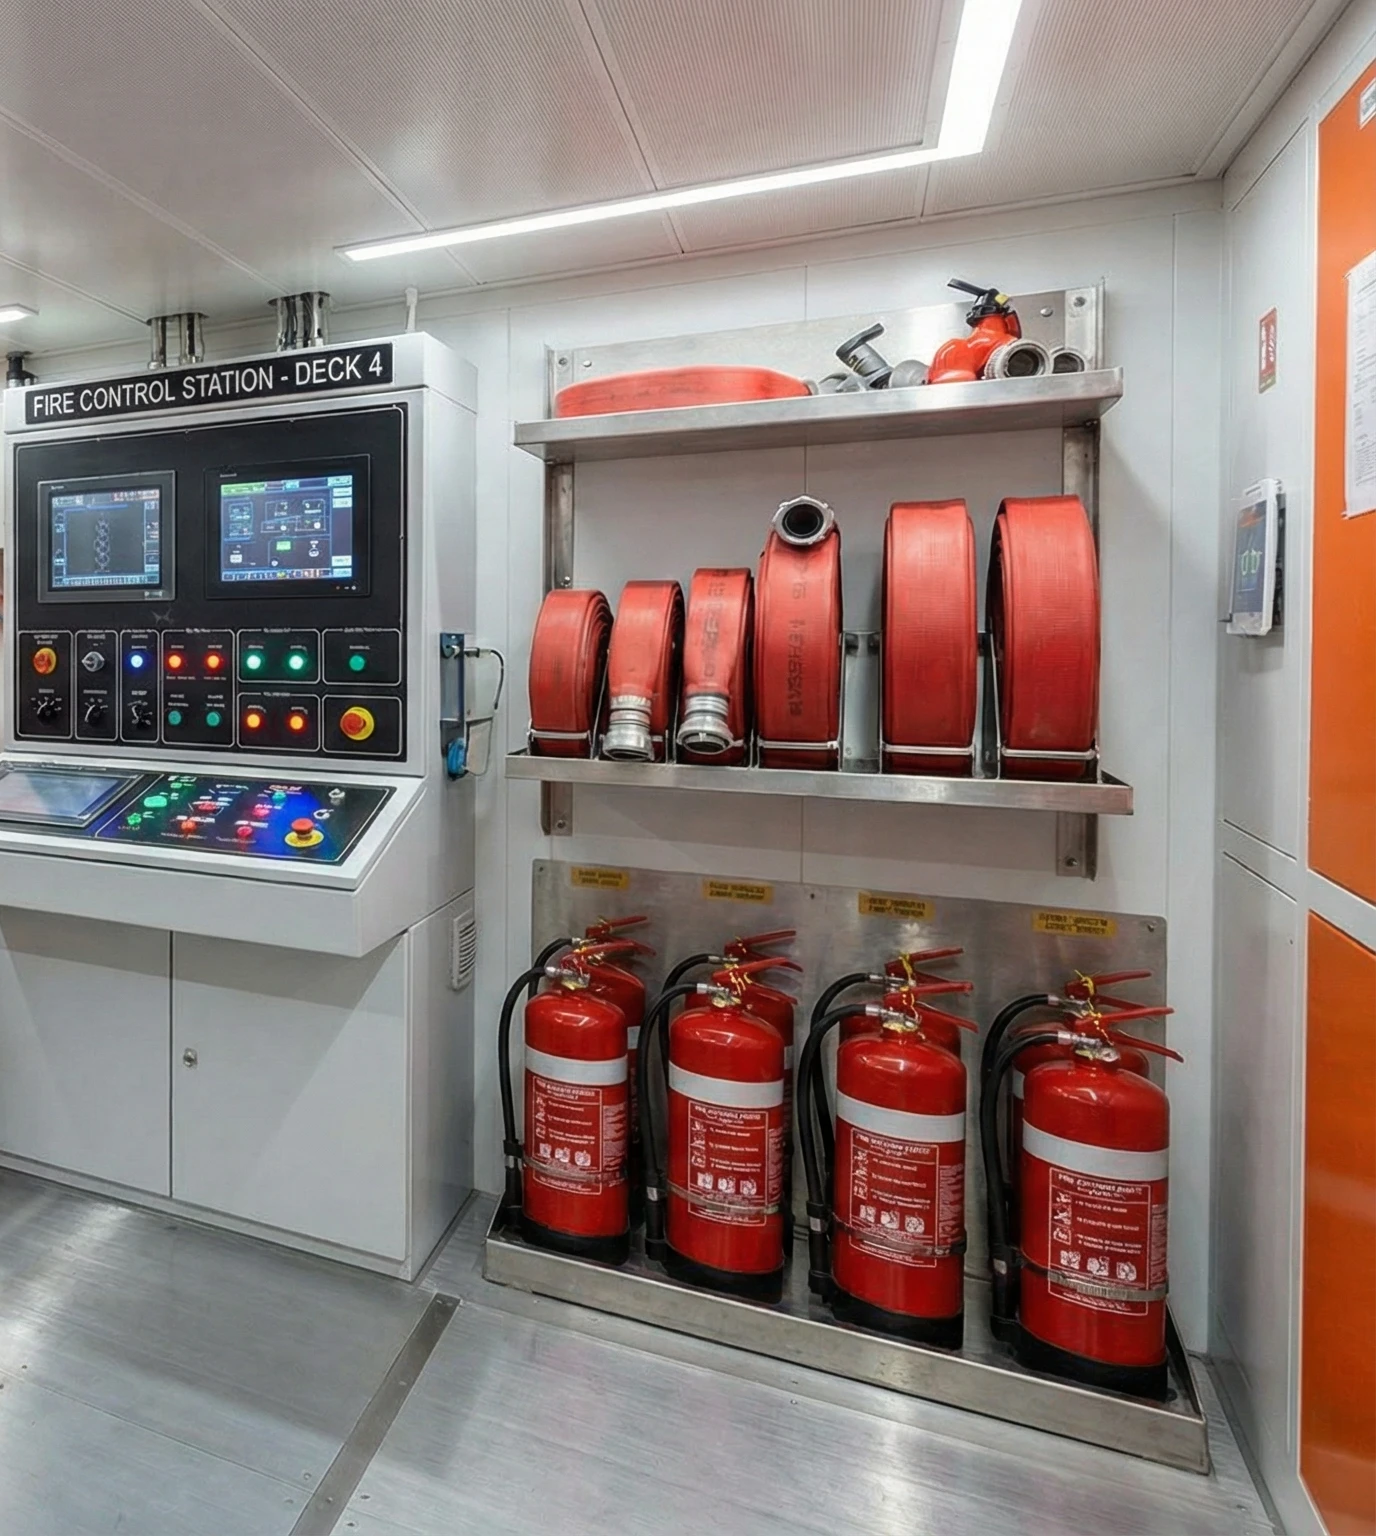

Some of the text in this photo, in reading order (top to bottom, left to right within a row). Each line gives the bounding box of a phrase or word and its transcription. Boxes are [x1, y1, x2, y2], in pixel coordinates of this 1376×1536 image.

[34, 392, 74, 417] FIRE
[79, 379, 175, 412] CONTROL
[182, 365, 273, 400] STATION
[295, 354, 362, 386] DECK
[369, 351, 383, 377] 4
